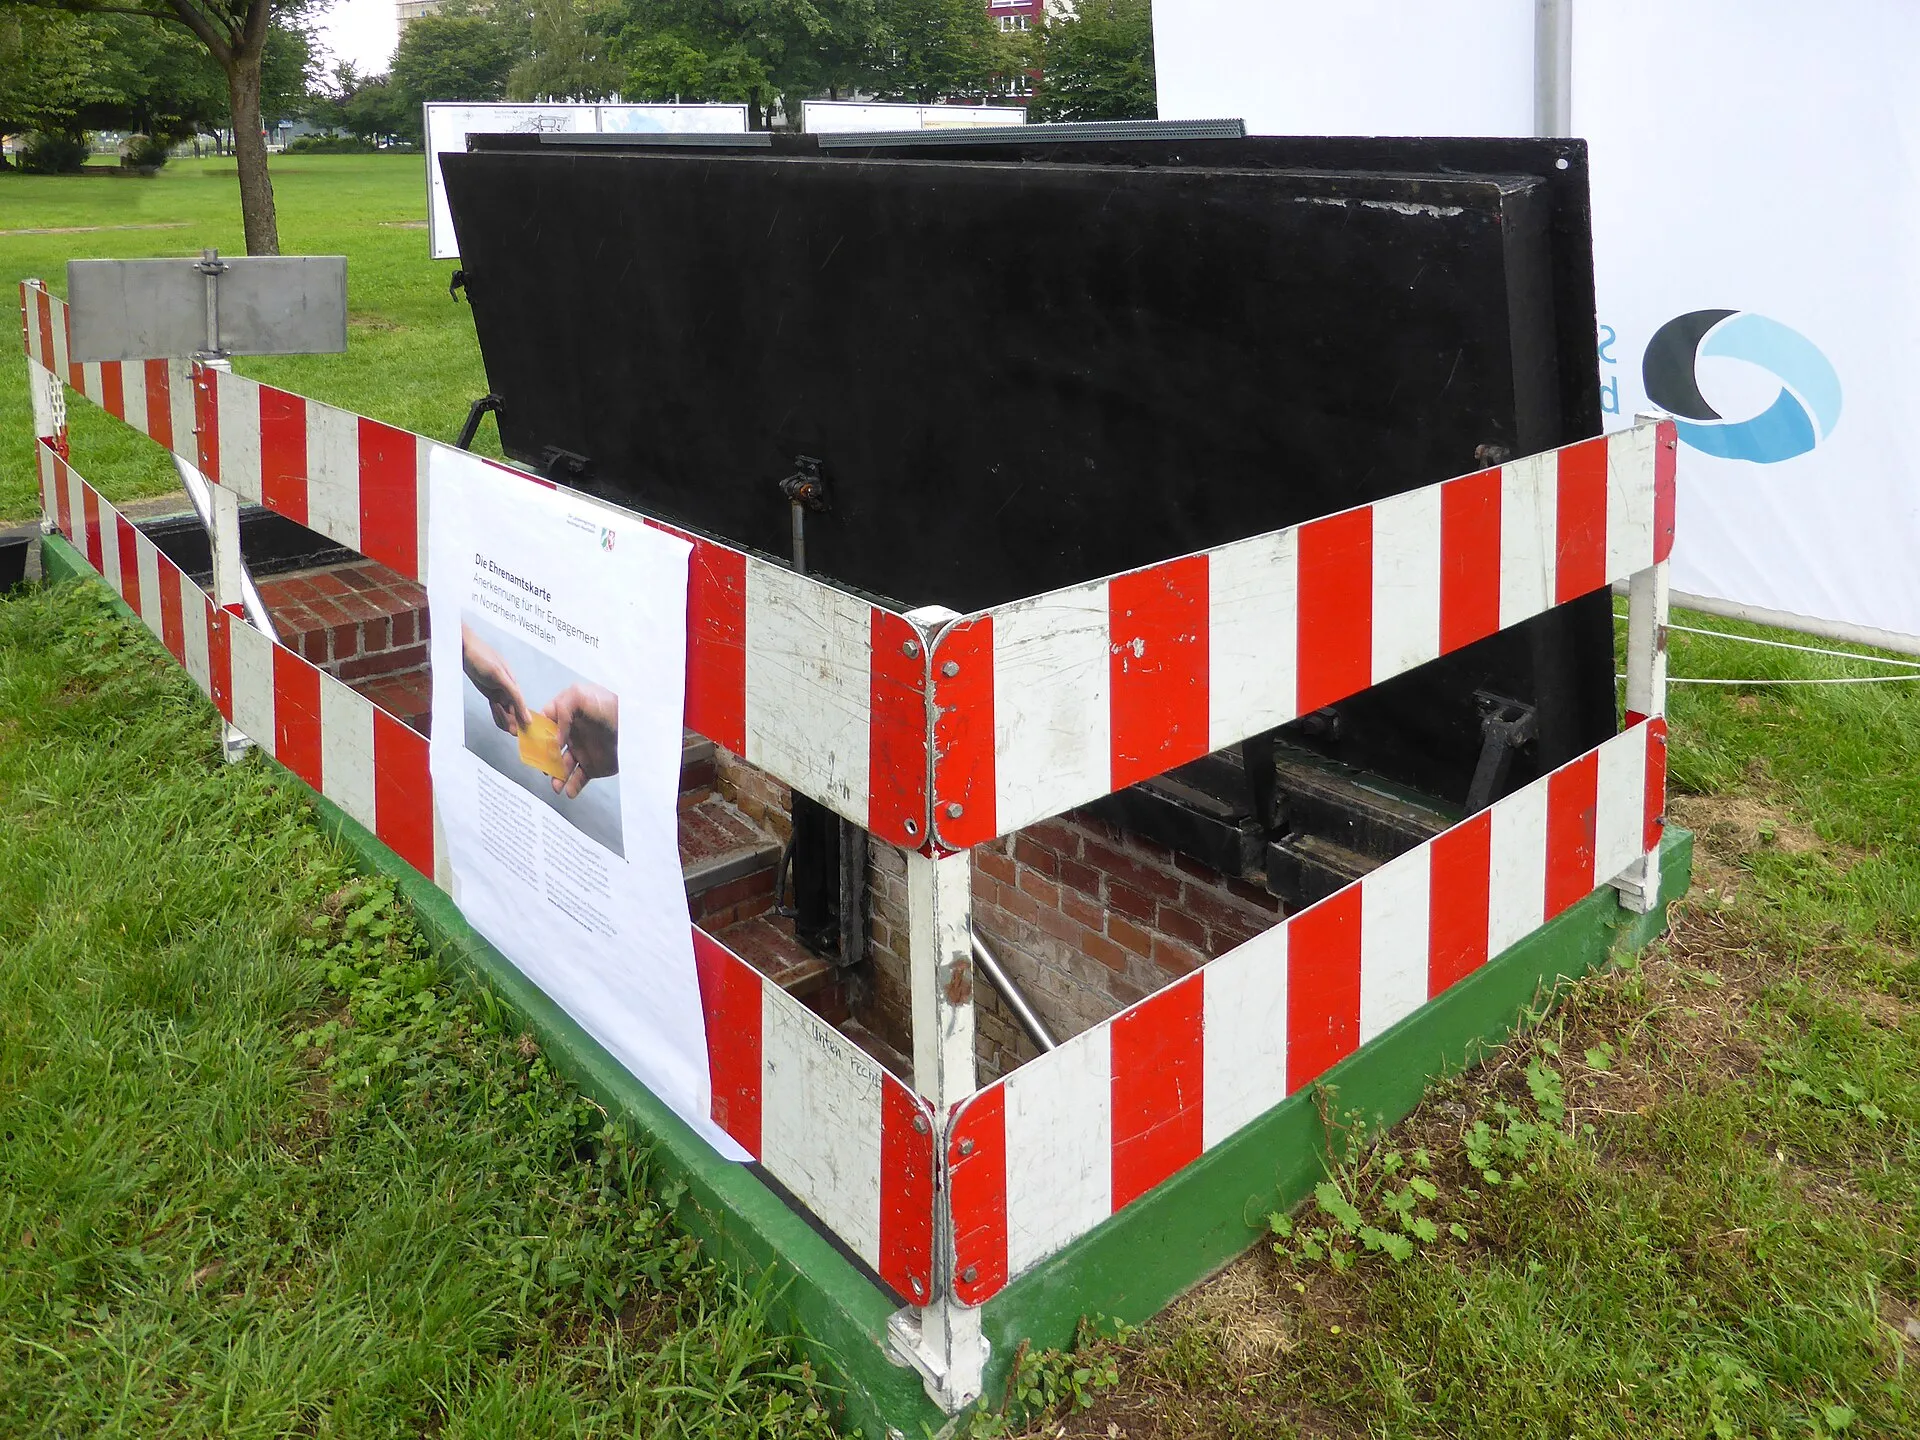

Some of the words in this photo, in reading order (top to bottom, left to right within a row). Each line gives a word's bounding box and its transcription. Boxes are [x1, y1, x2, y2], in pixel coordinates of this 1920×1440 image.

[475, 553, 488, 569] Die
[489, 560, 552, 602] Ehrenamtskarte
[471, 592, 479, 603] in
[480, 593, 557, 646] Nordrhein-Westfalen
[473, 572, 520, 609] Anerkennung
[521, 598, 533, 613] für
[534, 603, 545, 619] Ihr
[547, 610, 600, 649] Engagement
